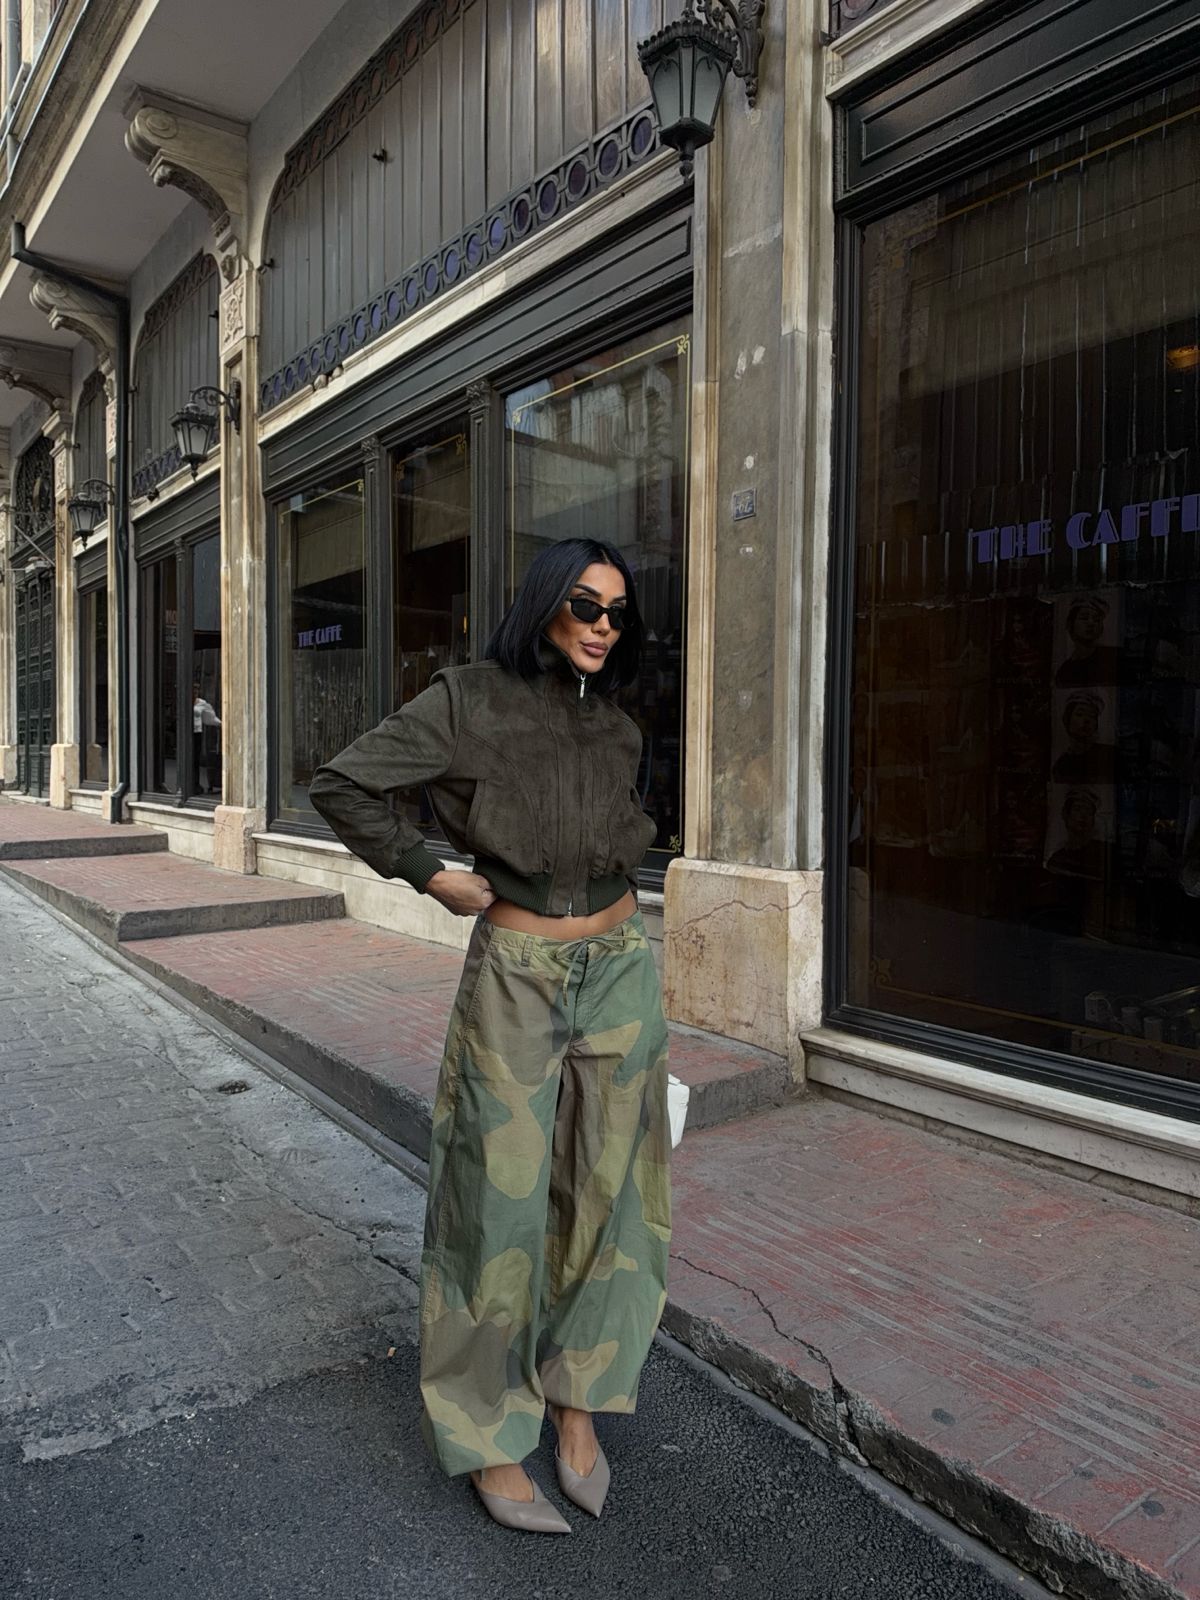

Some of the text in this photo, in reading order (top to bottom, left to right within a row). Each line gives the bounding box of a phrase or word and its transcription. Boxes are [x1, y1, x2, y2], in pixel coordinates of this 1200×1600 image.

[972, 518, 1052, 564] THE
[297, 624, 343, 648] THE CAFFE
